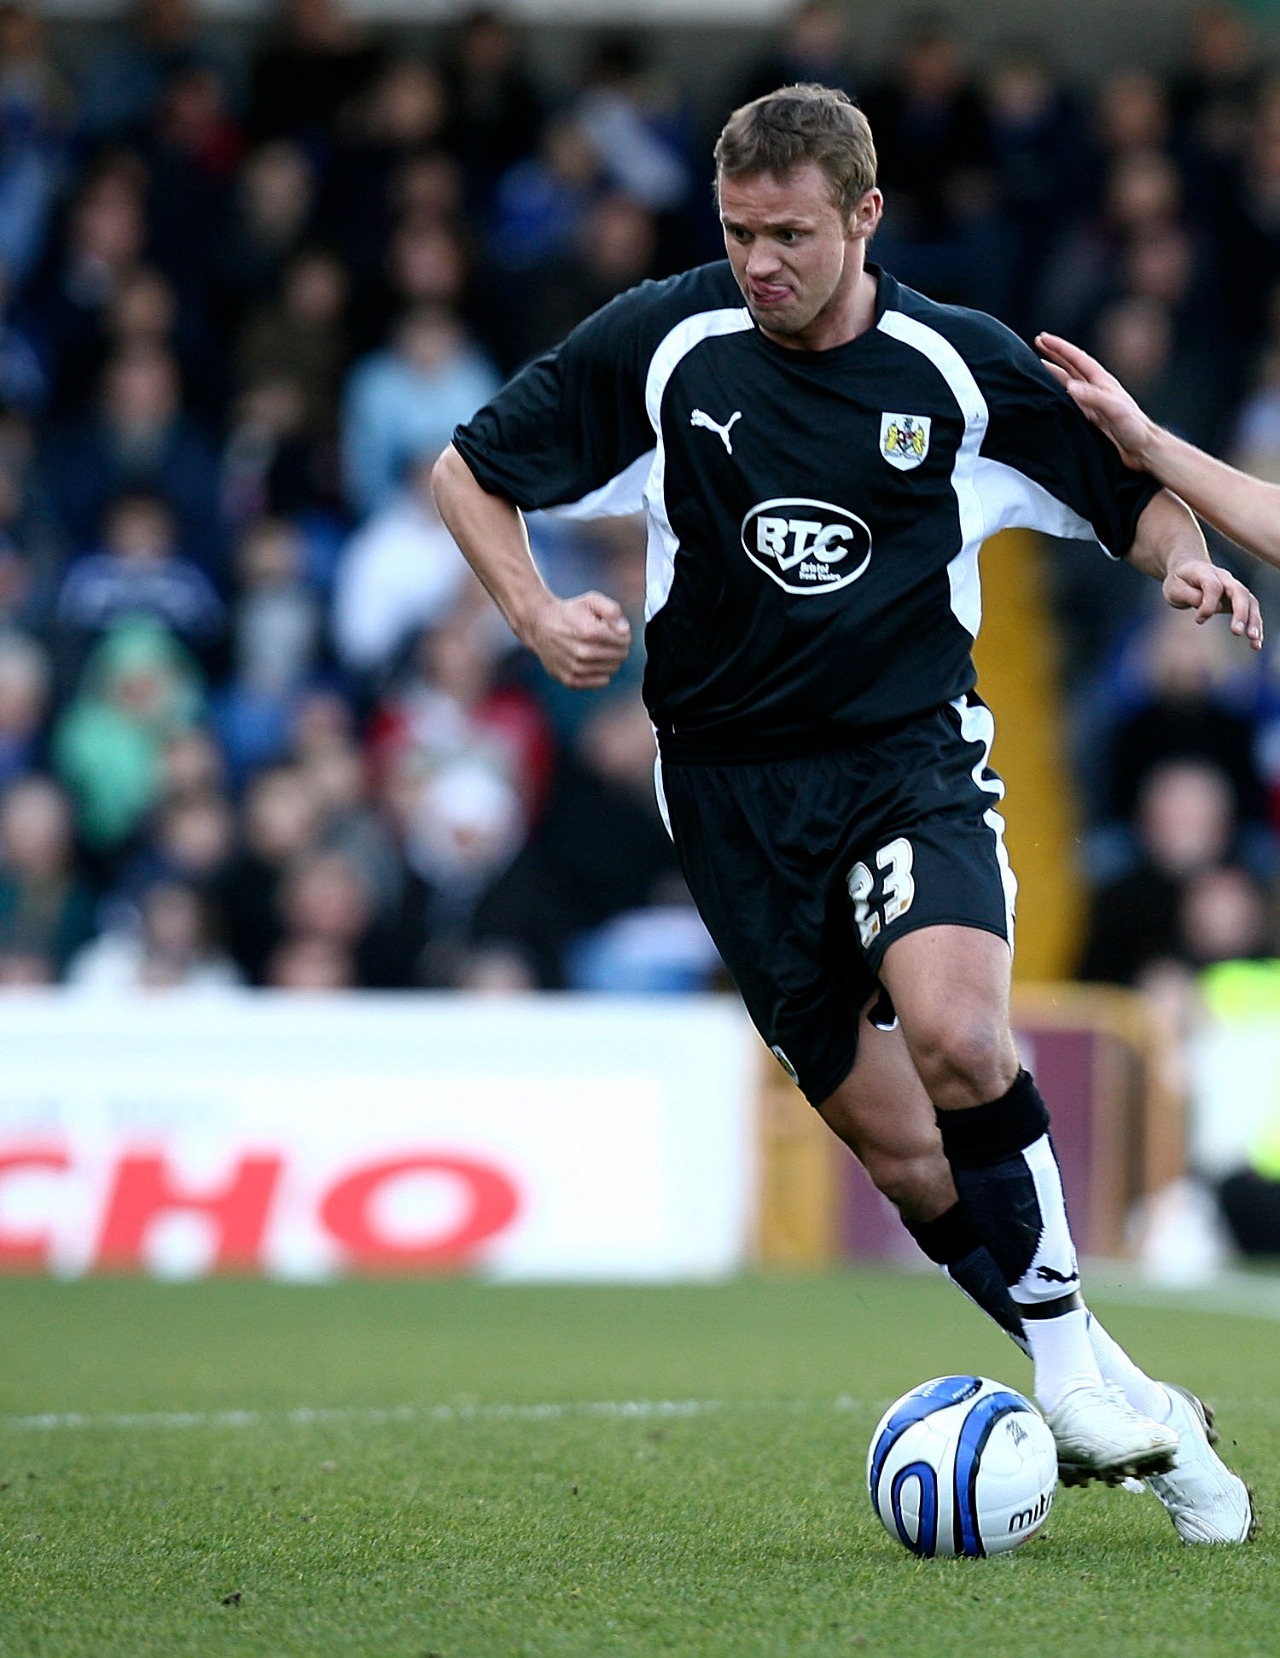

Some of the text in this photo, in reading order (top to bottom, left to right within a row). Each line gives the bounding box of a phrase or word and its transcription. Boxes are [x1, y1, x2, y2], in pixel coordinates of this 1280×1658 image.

[756, 515, 854, 571] BTC
[845, 836, 916, 950] 23
[1008, 1481, 1058, 1533] mitr
